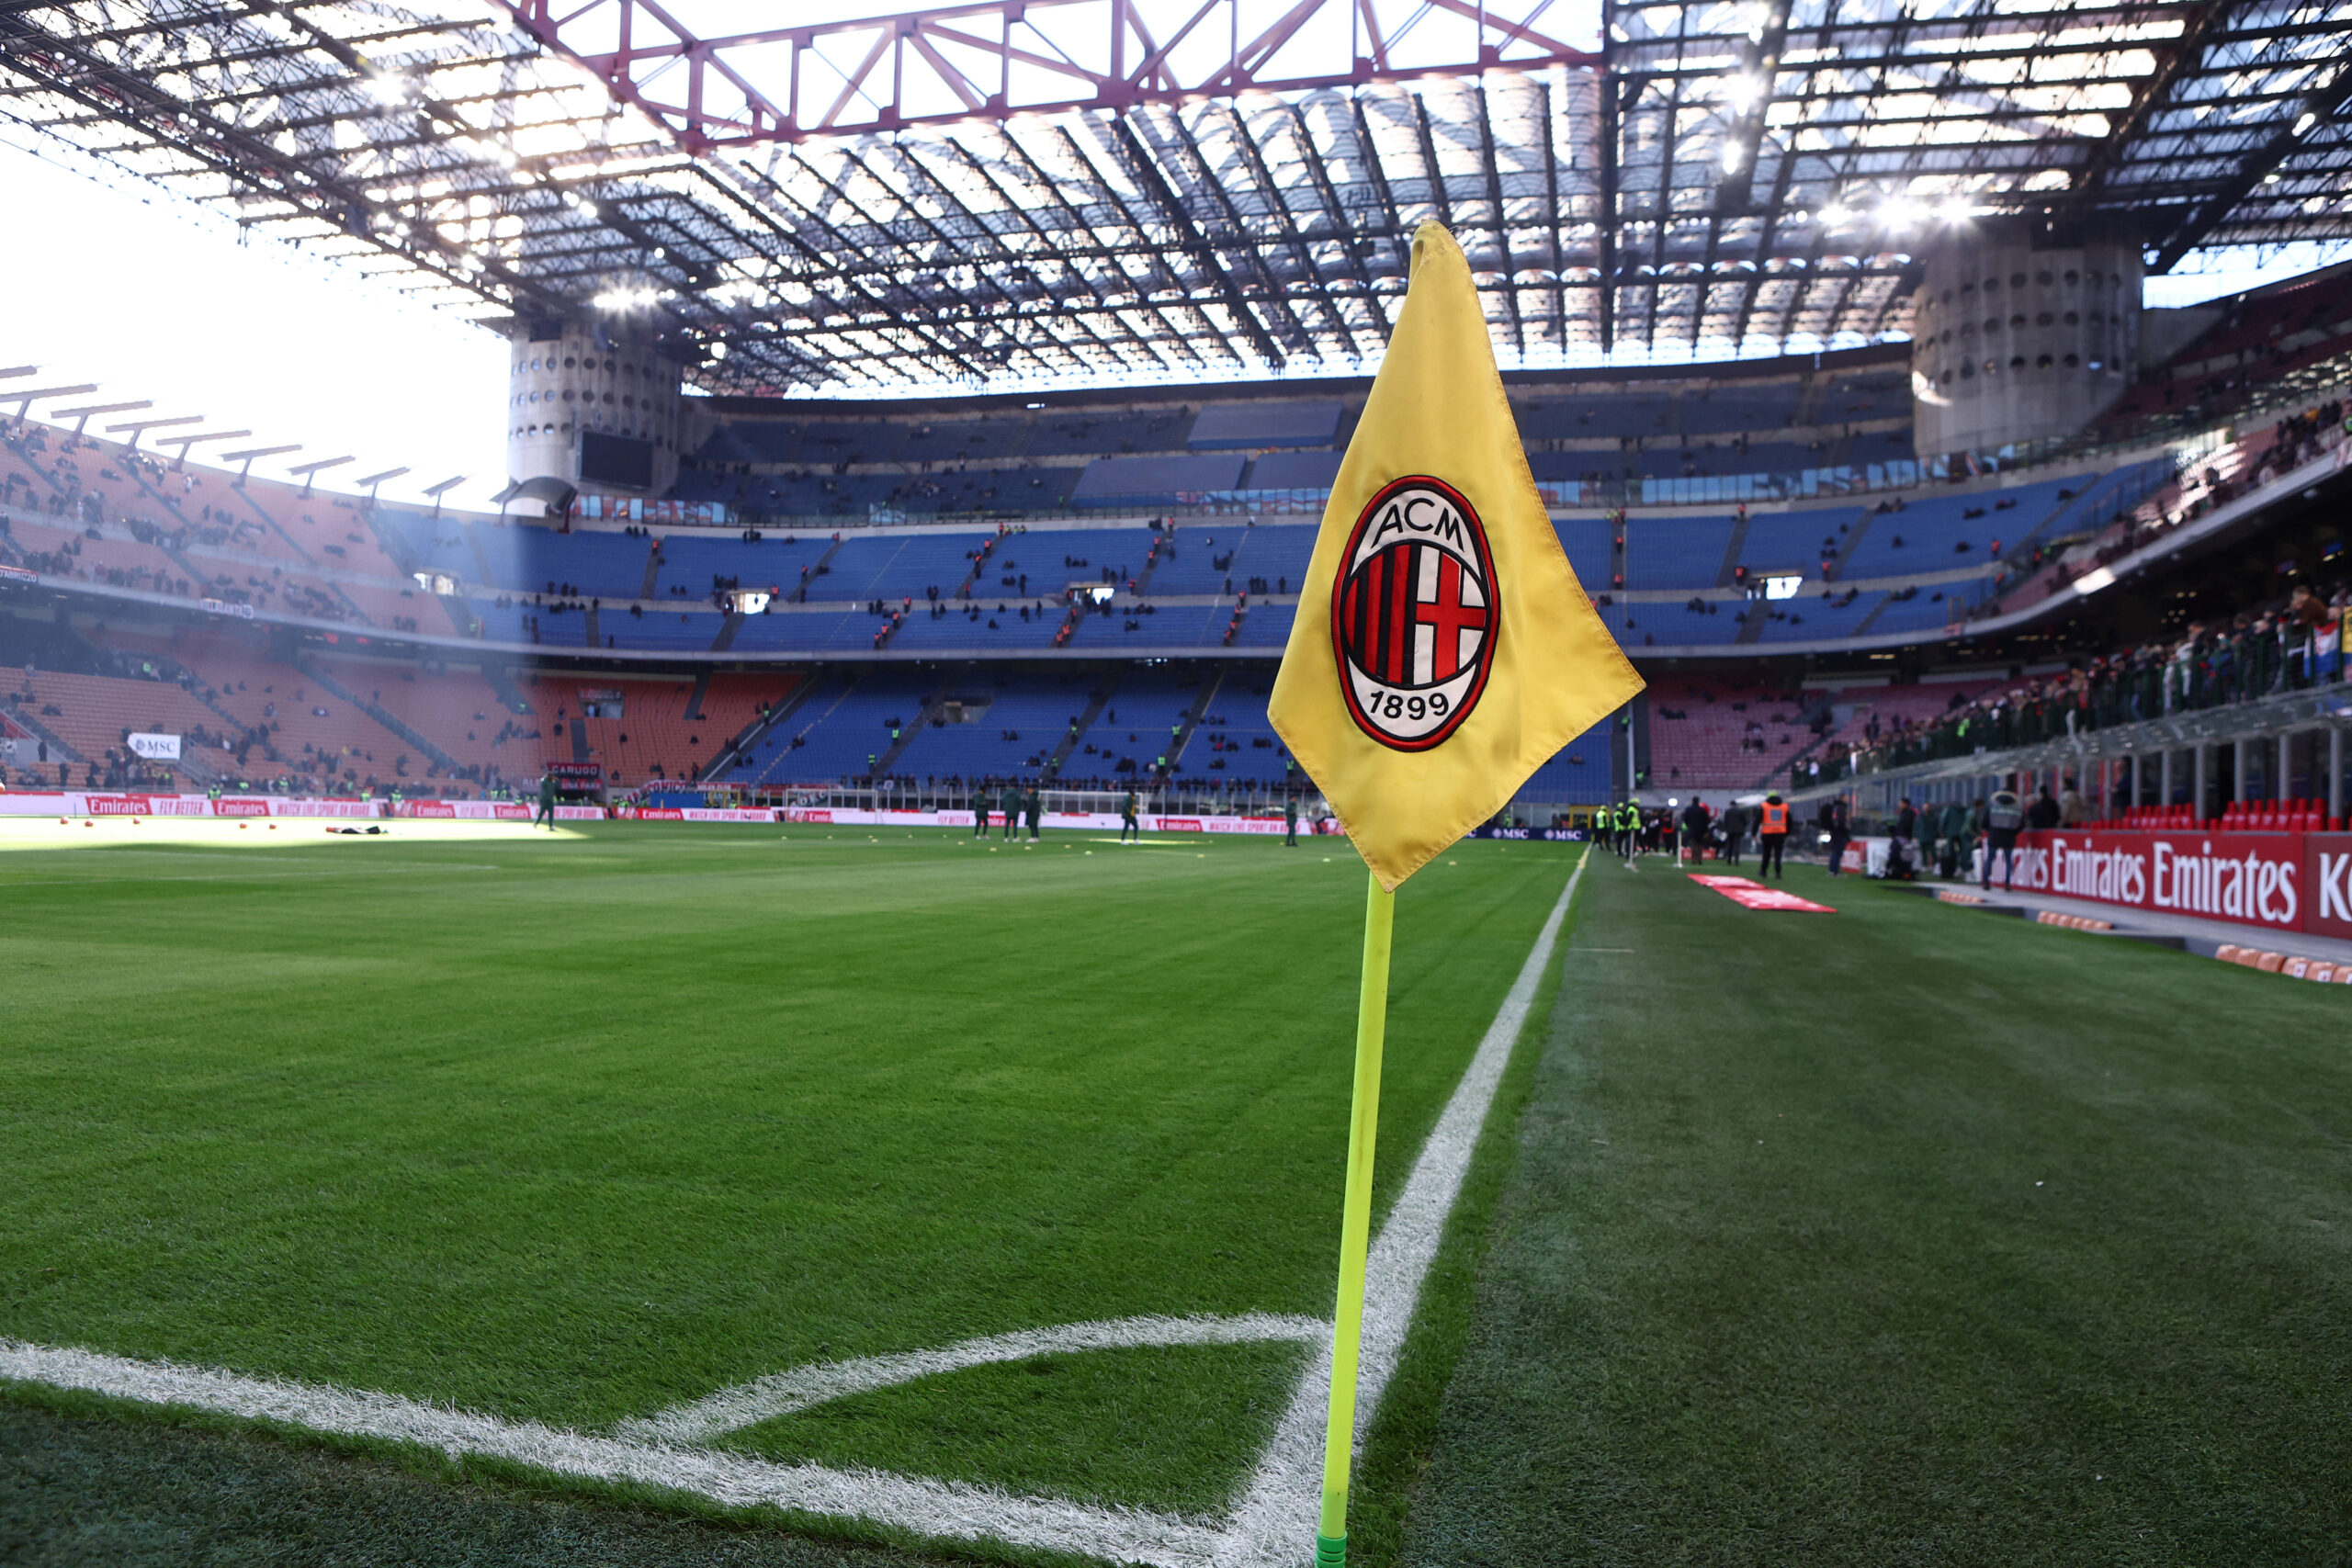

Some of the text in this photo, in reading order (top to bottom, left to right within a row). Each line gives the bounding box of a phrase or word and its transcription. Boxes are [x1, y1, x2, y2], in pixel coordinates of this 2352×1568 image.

[1371, 497, 1464, 553] ACM
[1370, 690, 1450, 721] 1899
[148, 740, 175, 752] MSC
[90, 799, 147, 814] Emirates
[159, 800, 173, 815] FLY
[219, 801, 266, 816] Emirates
[642, 808, 681, 819] Emirates
[1503, 829, 1530, 840] MSC
[1555, 829, 1582, 840] MSC
[2052, 837, 2146, 905] Emirates
[2153, 840, 2297, 923] Emirates
[2319, 852, 2352, 922] K
